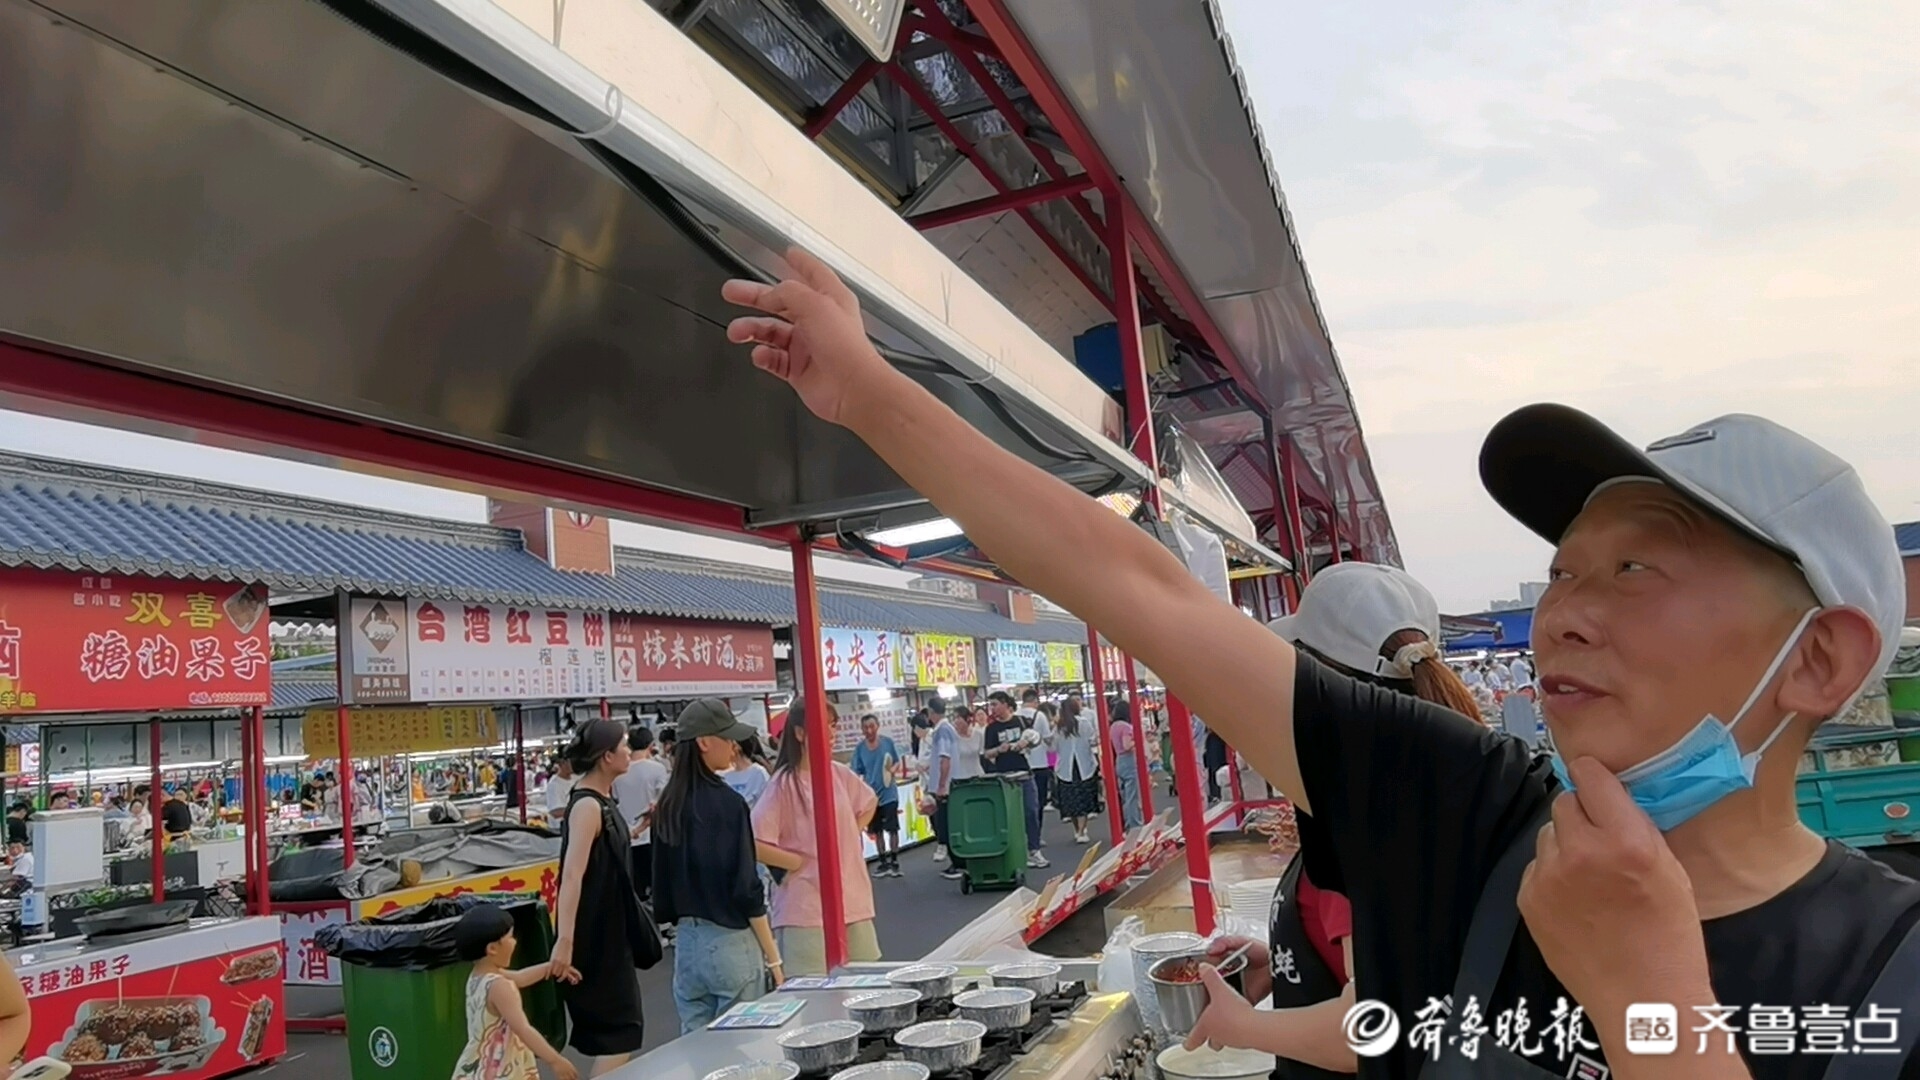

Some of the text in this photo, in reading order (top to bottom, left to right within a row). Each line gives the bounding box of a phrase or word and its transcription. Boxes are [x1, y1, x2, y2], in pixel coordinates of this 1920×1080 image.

[125, 591, 223, 629] 双喜
[416, 602, 604, 646] 台湾红豆饼
[80, 629, 267, 683] 糖油果子
[642, 628, 735, 672] 糯米甜酒
[824, 633, 893, 685] 玉米哥
